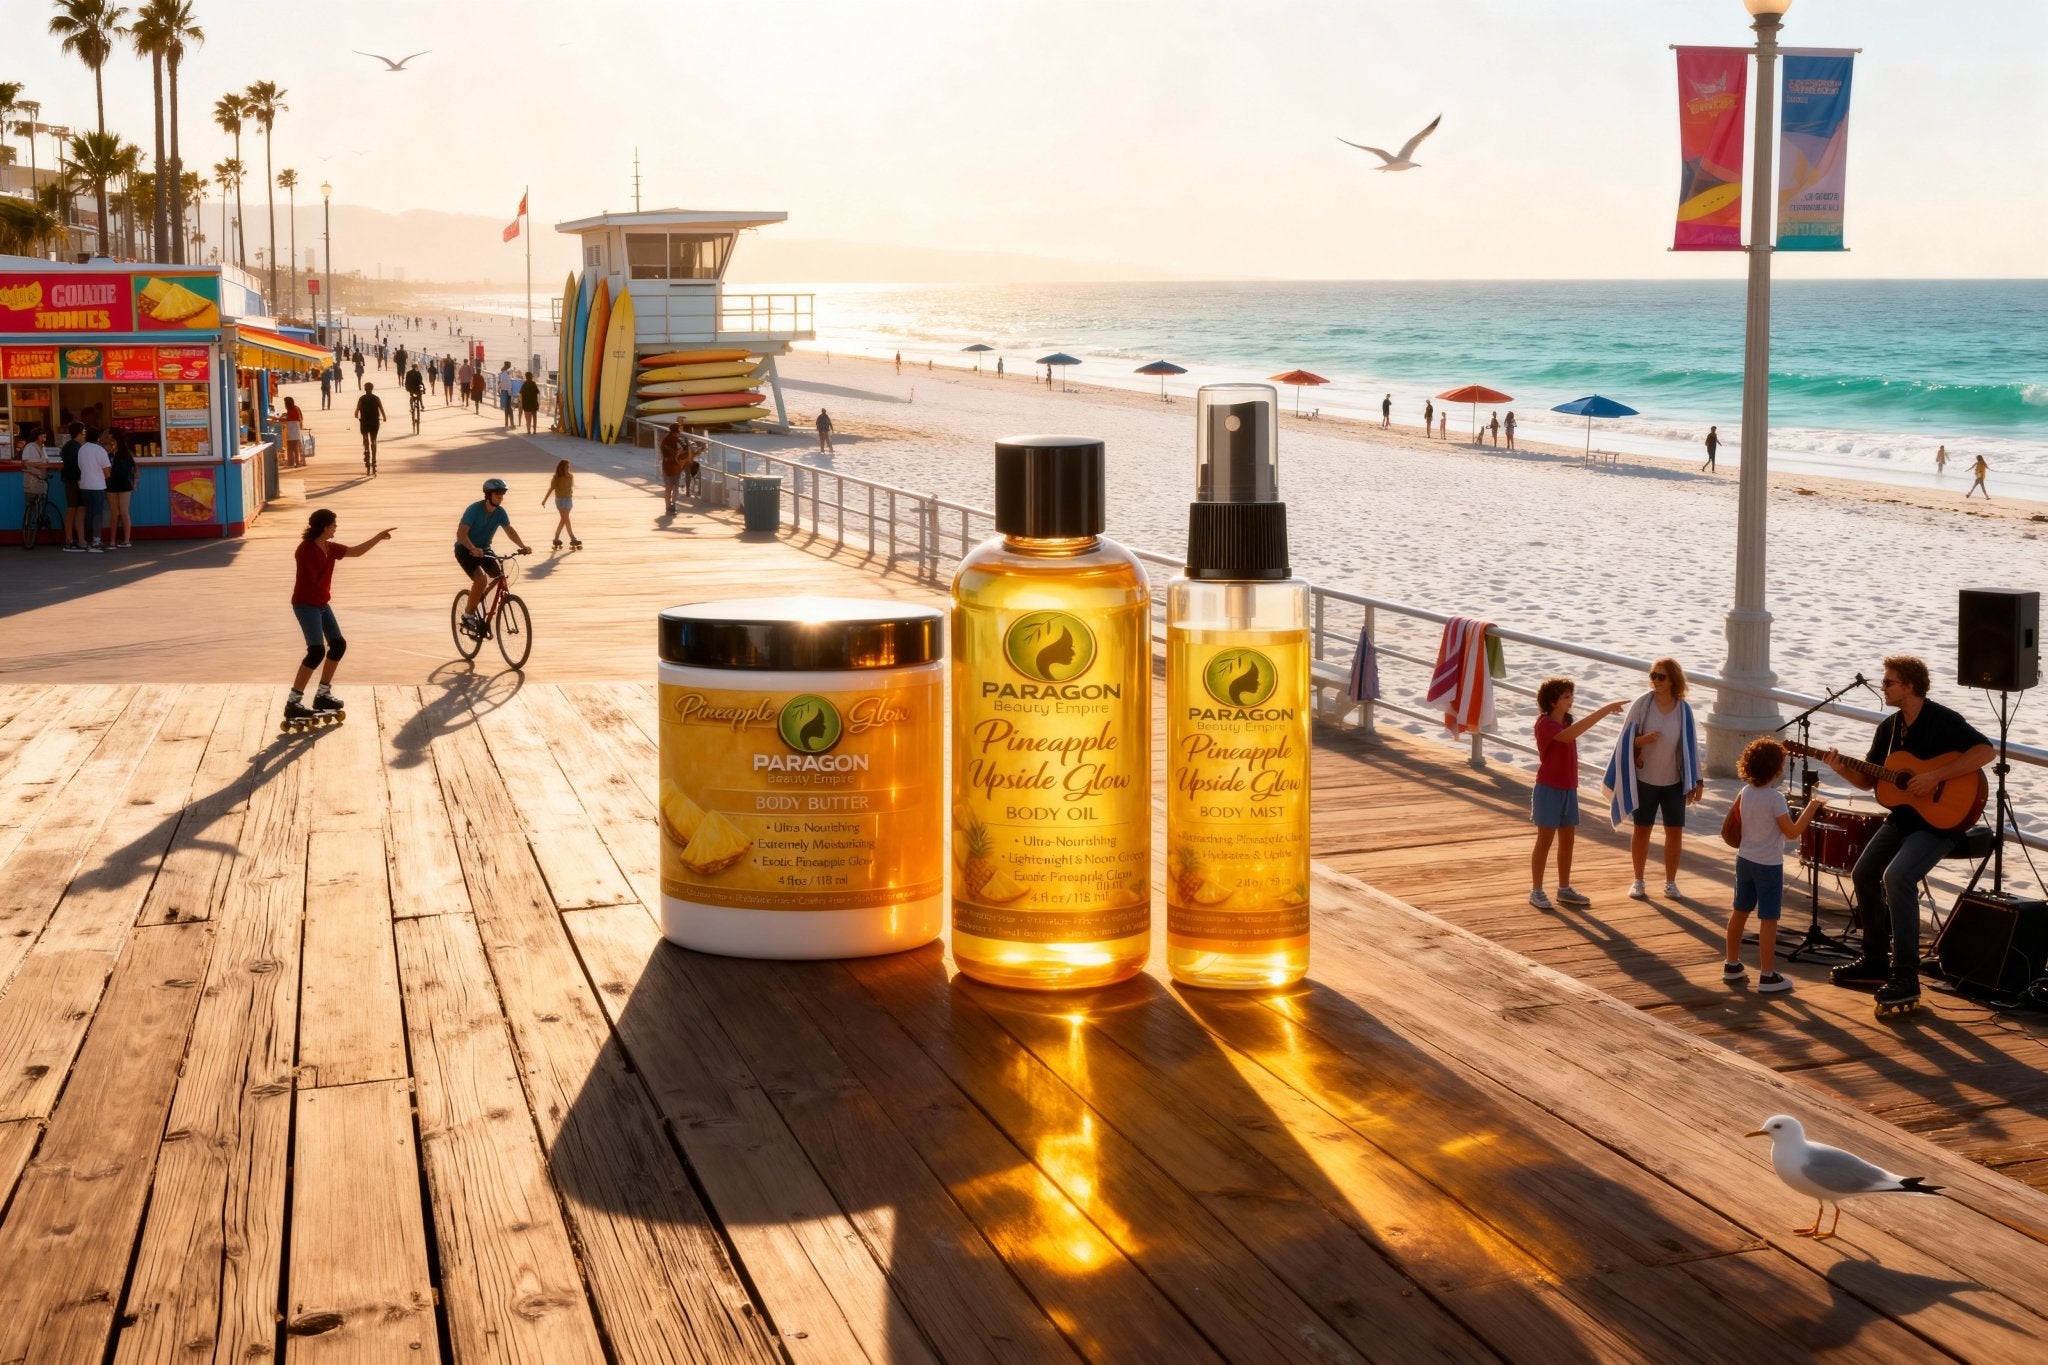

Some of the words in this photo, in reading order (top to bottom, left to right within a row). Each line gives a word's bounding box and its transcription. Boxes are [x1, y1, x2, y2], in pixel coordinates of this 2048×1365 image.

[982, 682, 1121, 700] PARAGON
[674, 693, 777, 734] Pineapple
[849, 696, 911, 734] Glow
[994, 701, 1050, 717] Beauty
[1055, 702, 1110, 717] Empire
[1188, 708, 1294, 721] PARAGON
[1197, 722, 1241, 734] Beauty
[1245, 722, 1286, 734] Empire
[974, 718, 1118, 767] Pineapple
[1181, 733, 1293, 771] Pineapple
[753, 754, 869, 772] PARAGON
[767, 774, 810, 786] Beauty
[814, 774, 855, 786] Empire
[968, 758, 1057, 801] Upside
[1063, 763, 1131, 802] Glow
[1176, 766, 1247, 801] Upside
[1251, 769, 1300, 802] Glow
[756, 796, 802, 810] BODY
[808, 796, 870, 810] BUTTER
[1006, 806, 1060, 821] BODY
[1067, 807, 1099, 821] OIL
[1200, 806, 1244, 818] BODY
[1250, 806, 1286, 818] MIST
